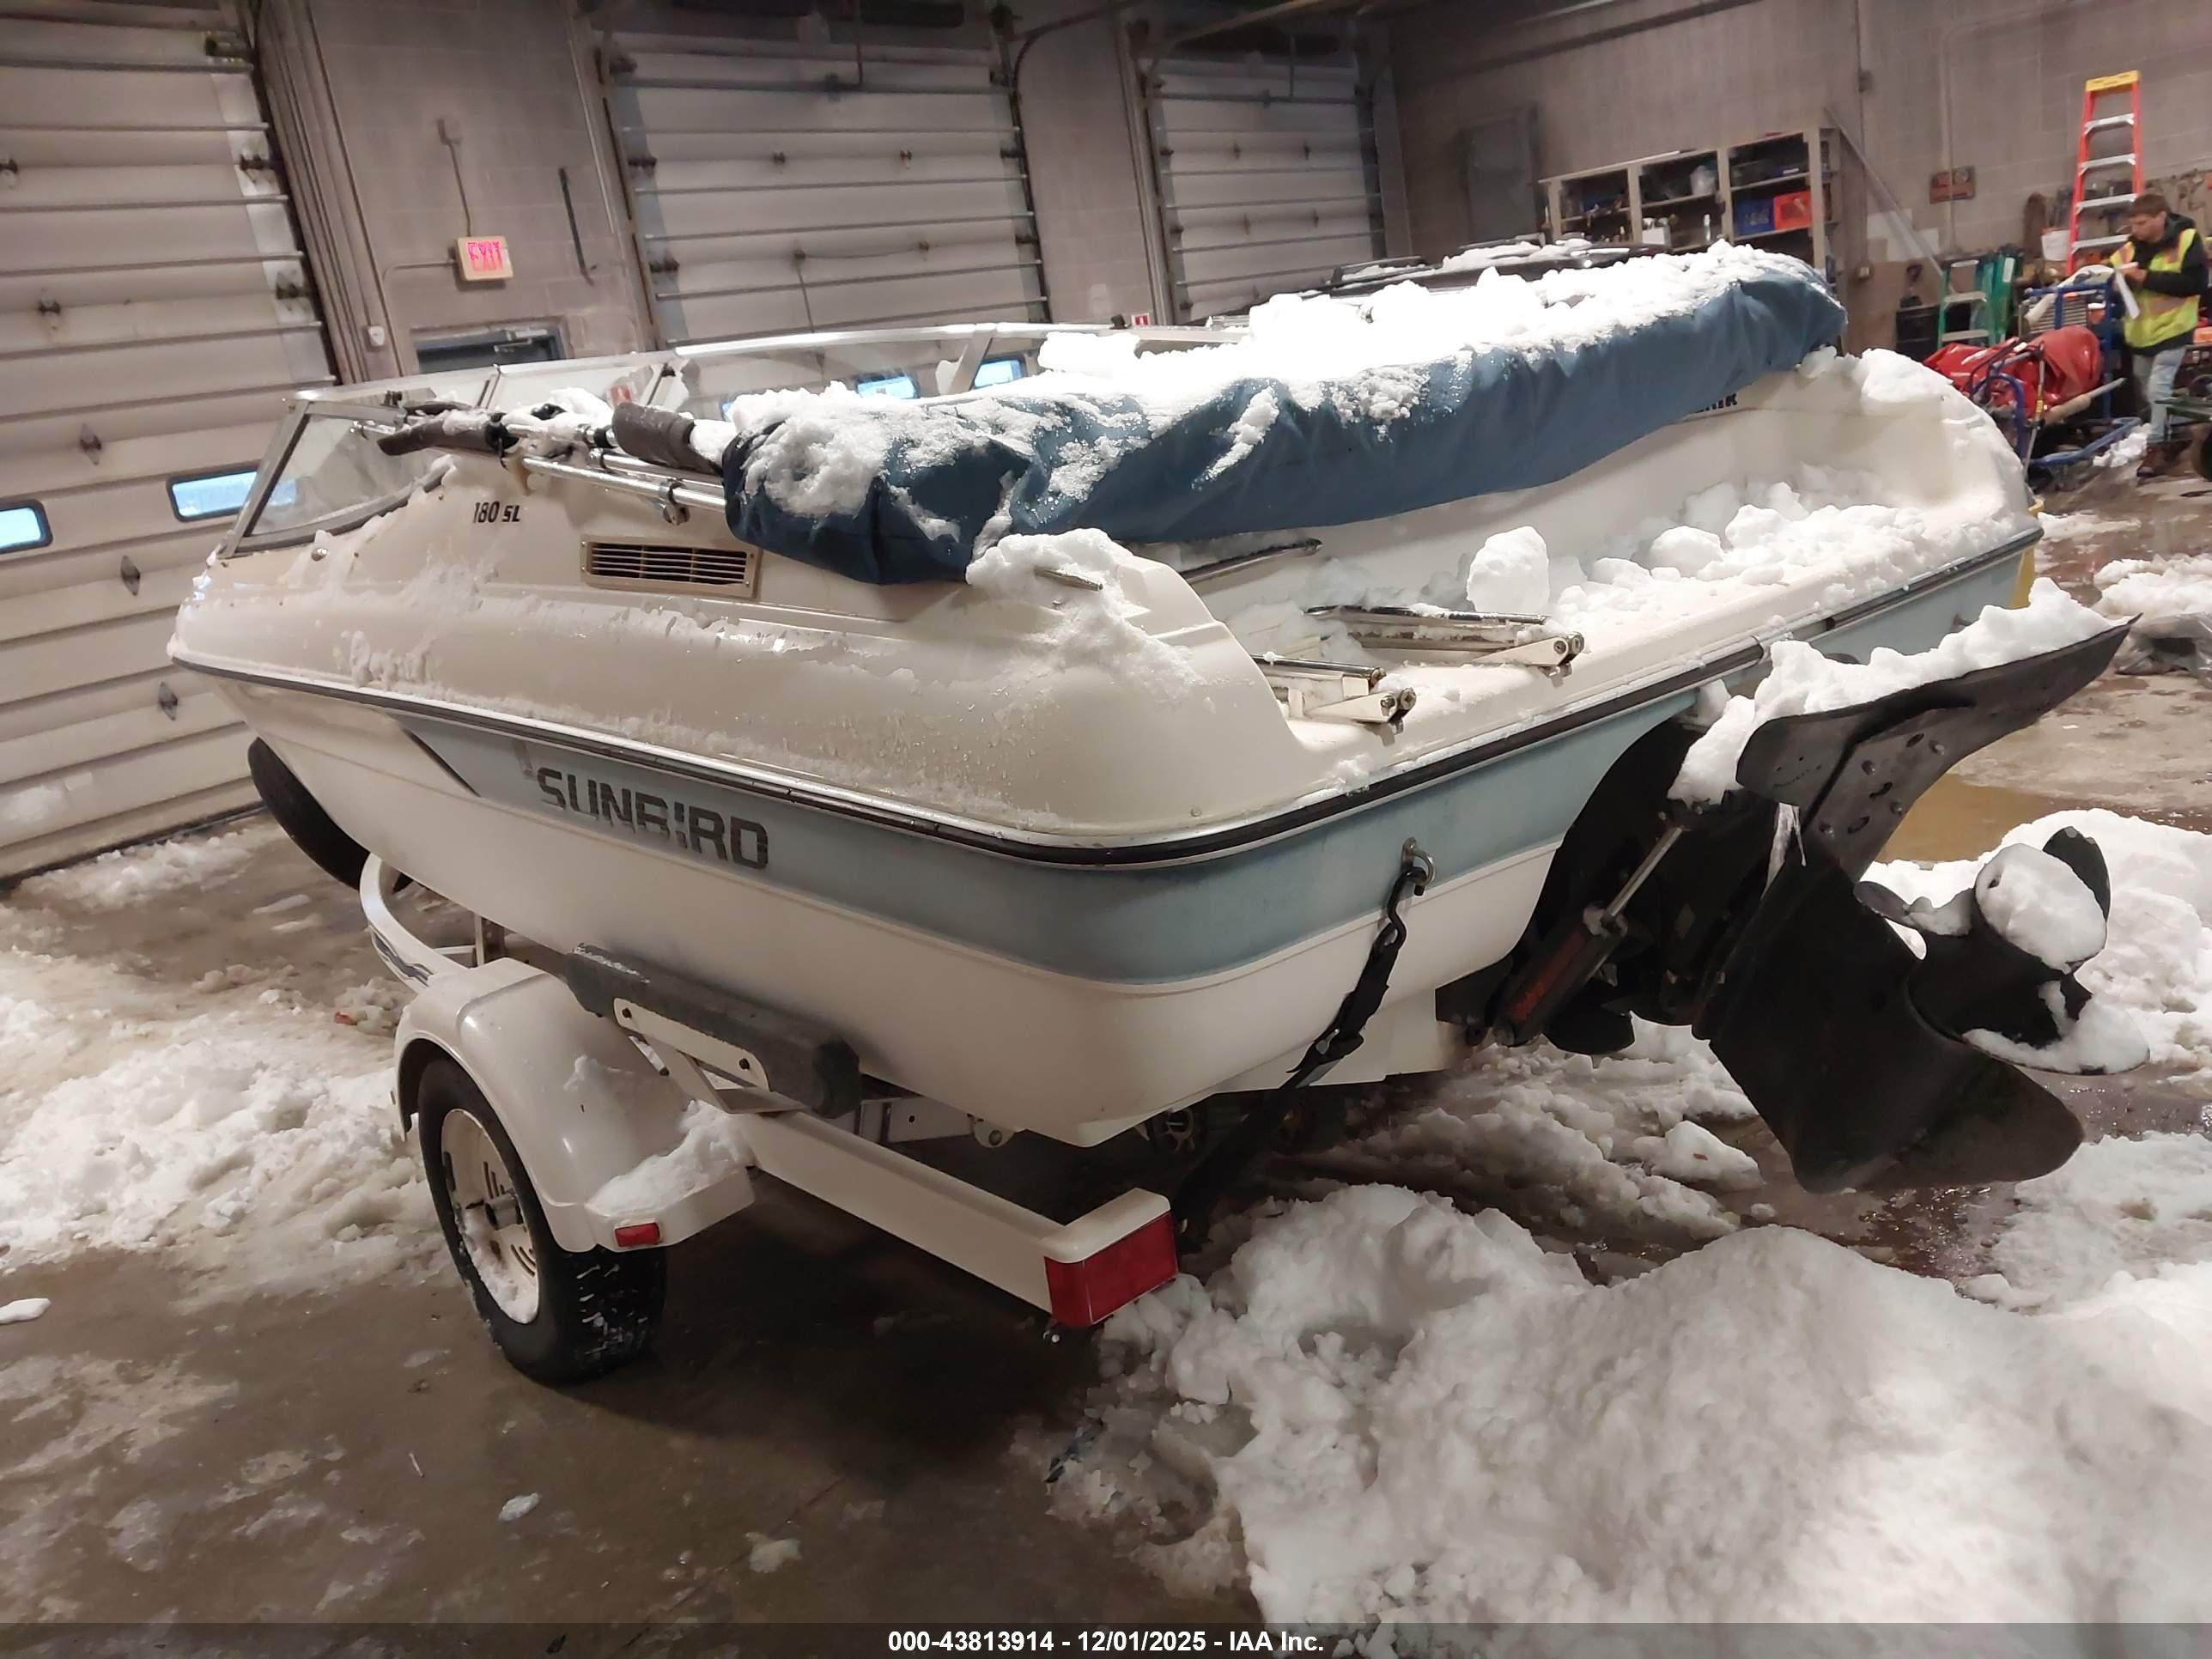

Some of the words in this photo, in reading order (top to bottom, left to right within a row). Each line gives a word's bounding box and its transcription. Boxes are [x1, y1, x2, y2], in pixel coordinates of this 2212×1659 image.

[467, 240, 504, 272] EXIT
[472, 501, 501, 524] 180
[501, 504, 520, 523] SL
[536, 767, 769, 870] SUNBIRD
